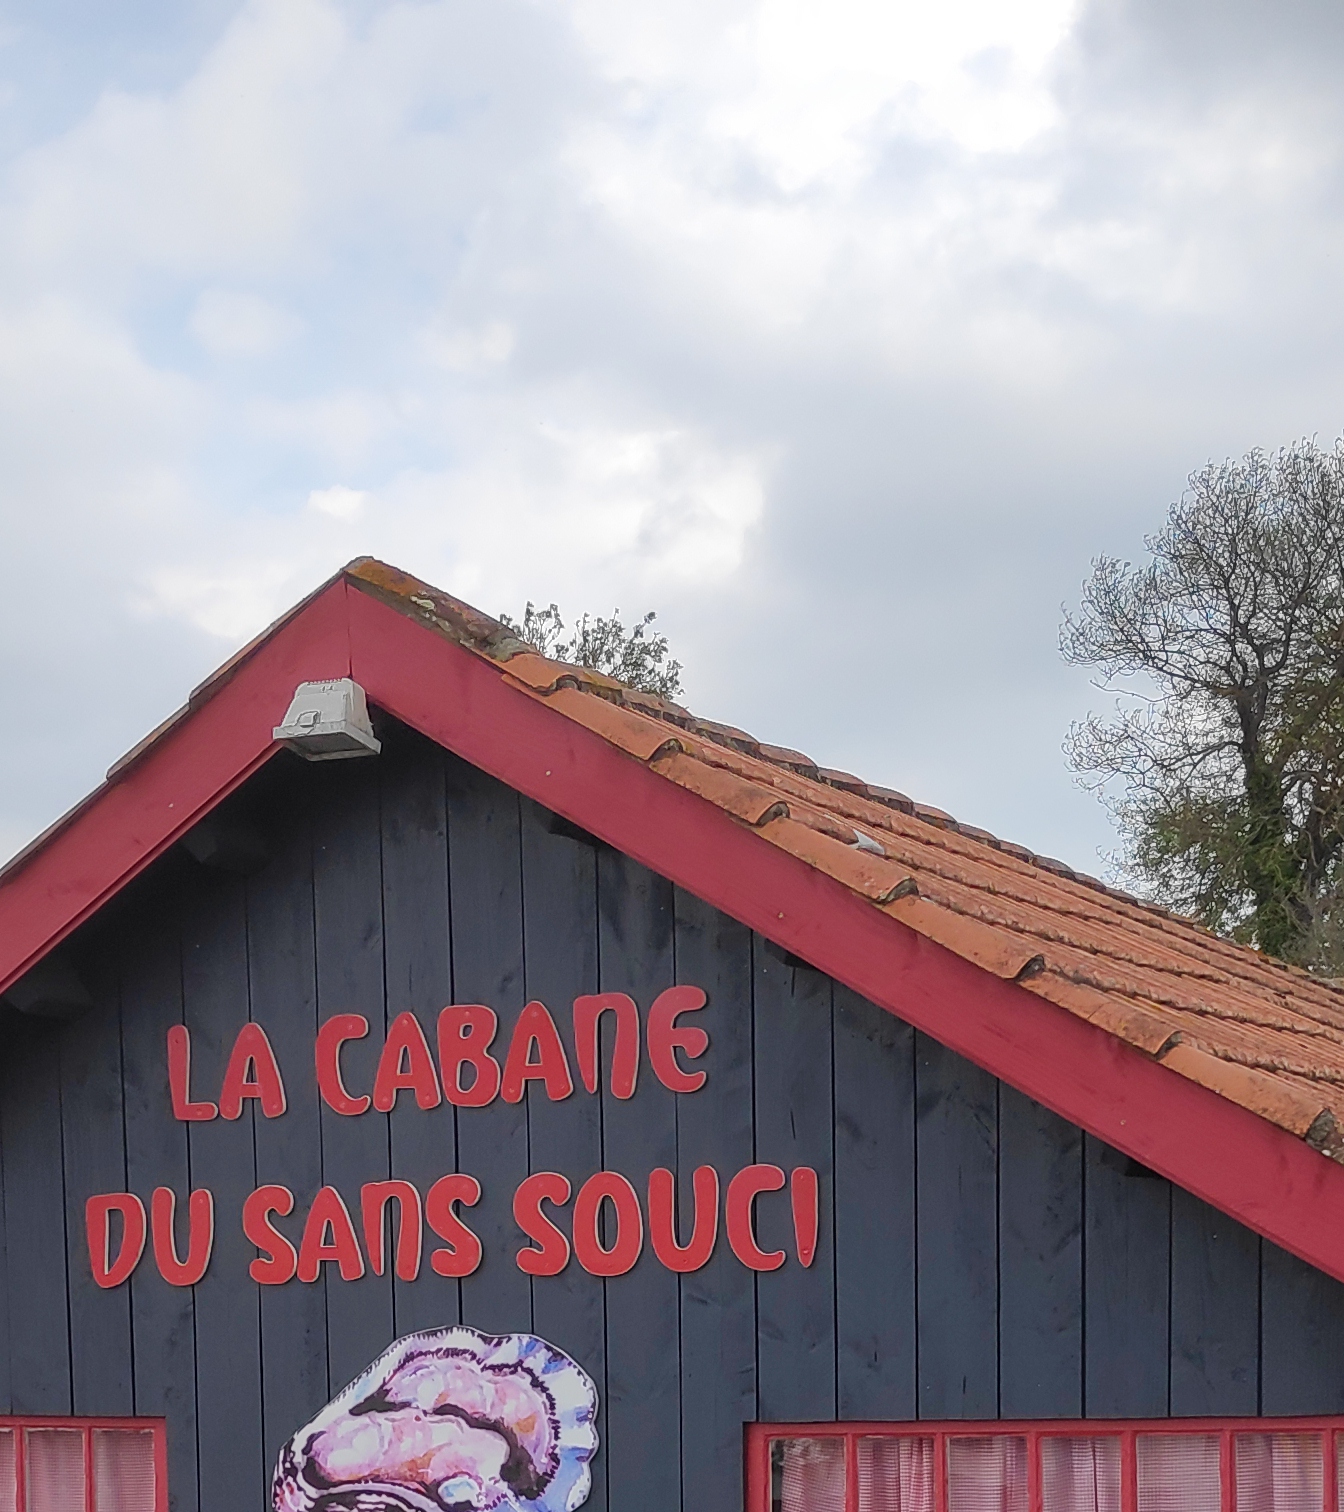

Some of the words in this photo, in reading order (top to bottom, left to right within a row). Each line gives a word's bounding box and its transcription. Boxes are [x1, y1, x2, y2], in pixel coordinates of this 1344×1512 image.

[166, 1021, 287, 1121] LA
[314, 985, 709, 1117] CABANE
[85, 1186, 215, 1289] DU
[242, 1172, 484, 1285] SANS
[512, 1164, 820, 1278] SOUCI
